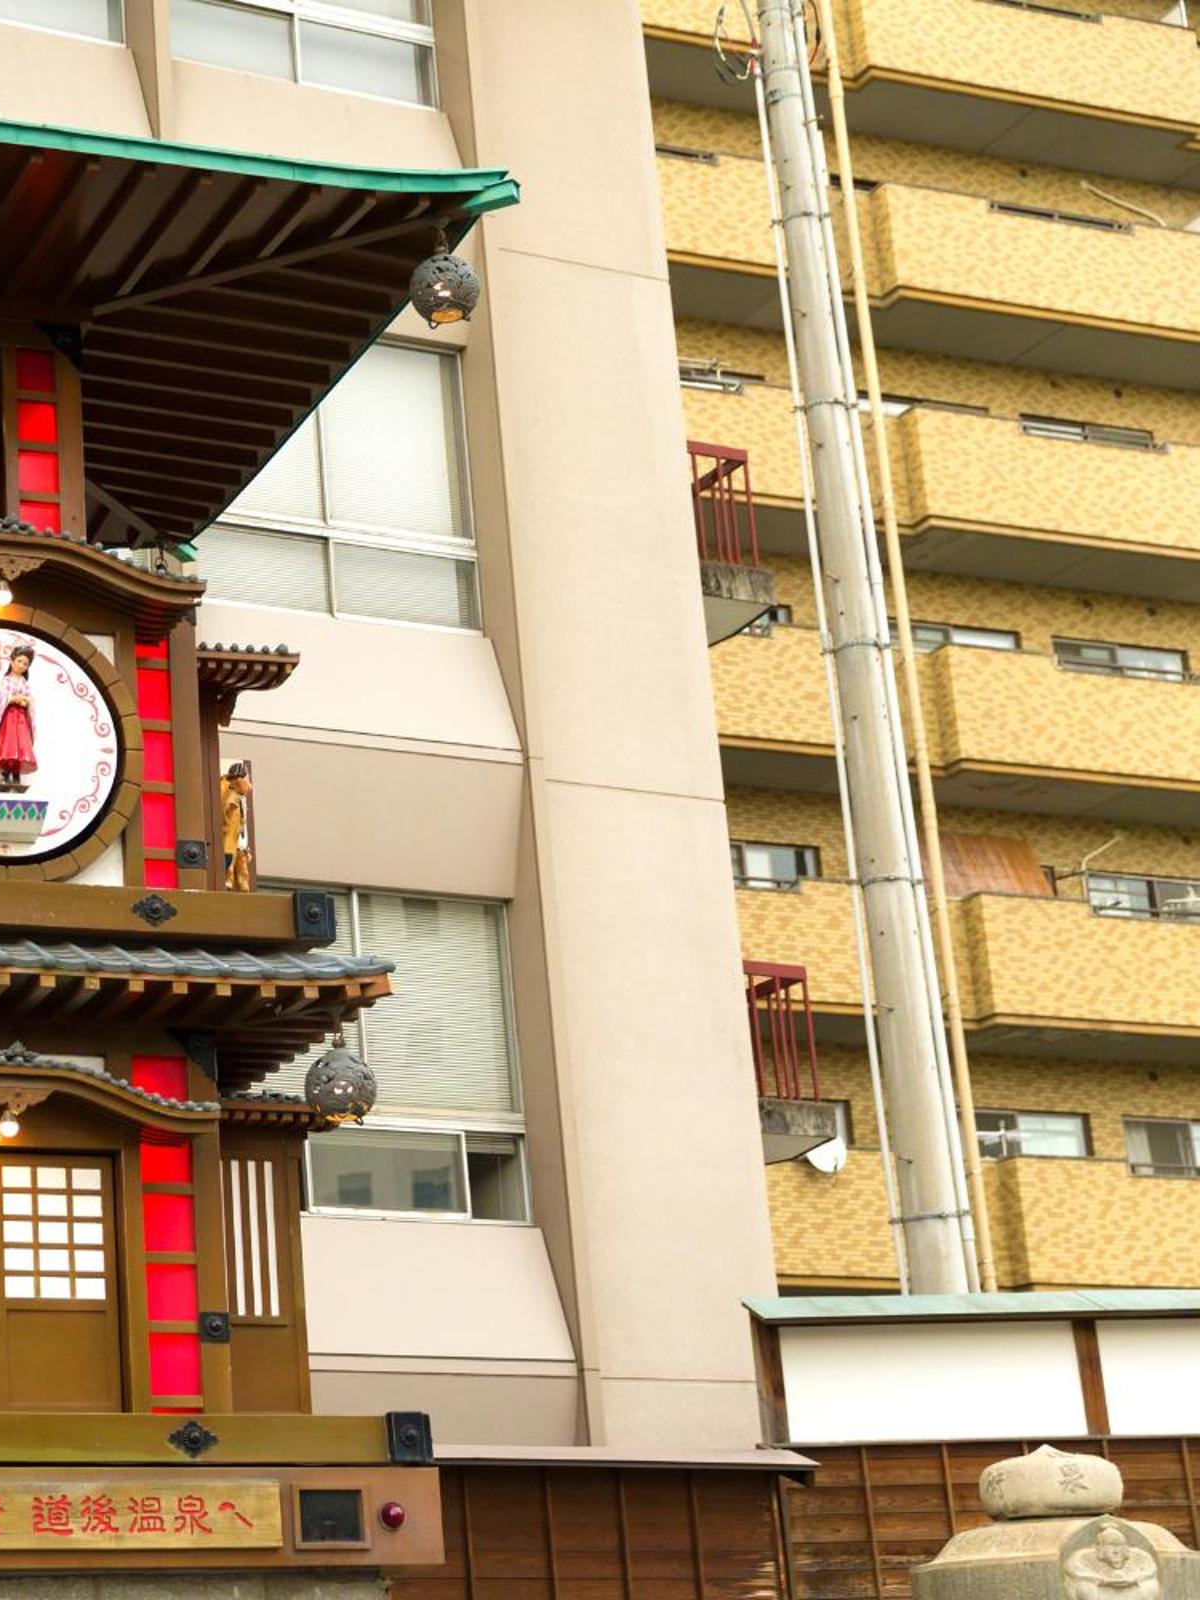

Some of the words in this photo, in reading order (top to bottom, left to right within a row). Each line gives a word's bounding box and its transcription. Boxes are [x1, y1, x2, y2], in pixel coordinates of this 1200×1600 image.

[31, 1494, 254, 1536] 道後温泉へ
